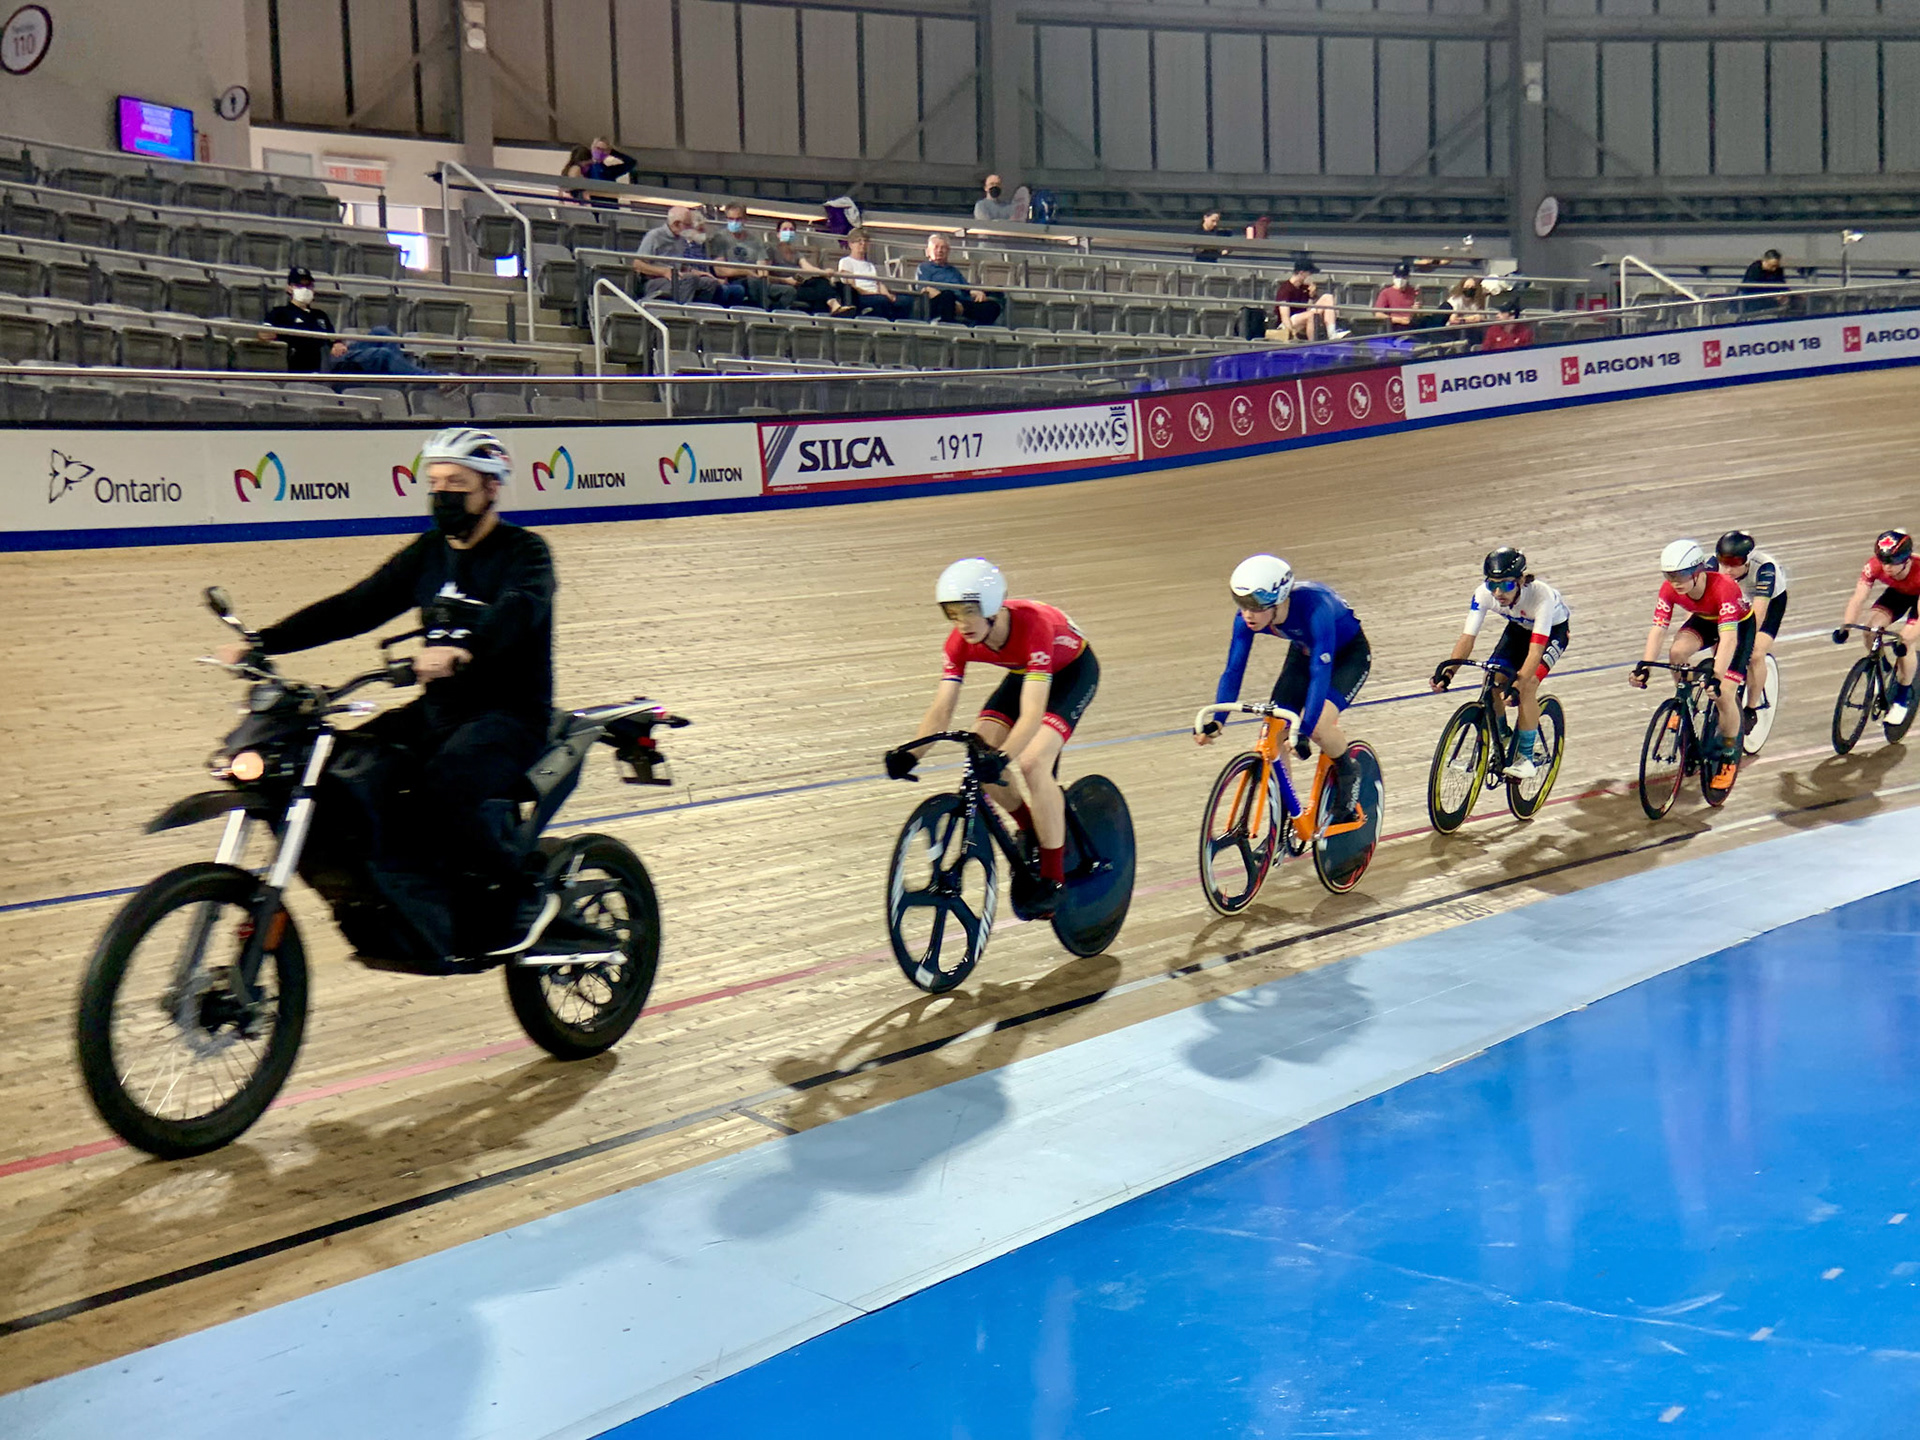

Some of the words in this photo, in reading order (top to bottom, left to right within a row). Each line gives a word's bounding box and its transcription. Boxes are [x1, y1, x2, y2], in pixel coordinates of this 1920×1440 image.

[14, 34, 36, 57] 110
[1866, 327, 1920, 344] ARGO
[1725, 339, 1795, 358] ARGON
[1798, 337, 1821, 350] 18
[1583, 355, 1654, 376] ARGON
[1658, 353, 1681, 366] 18
[1440, 371, 1511, 393] ARGON
[1515, 369, 1538, 384] 18
[797, 437, 895, 472] SILCA
[937, 433, 982, 460] 1917
[577, 473, 626, 490] MILTON
[699, 467, 743, 484] MILTON
[95, 477, 182, 503] Ontario
[290, 482, 350, 501] MILTON
